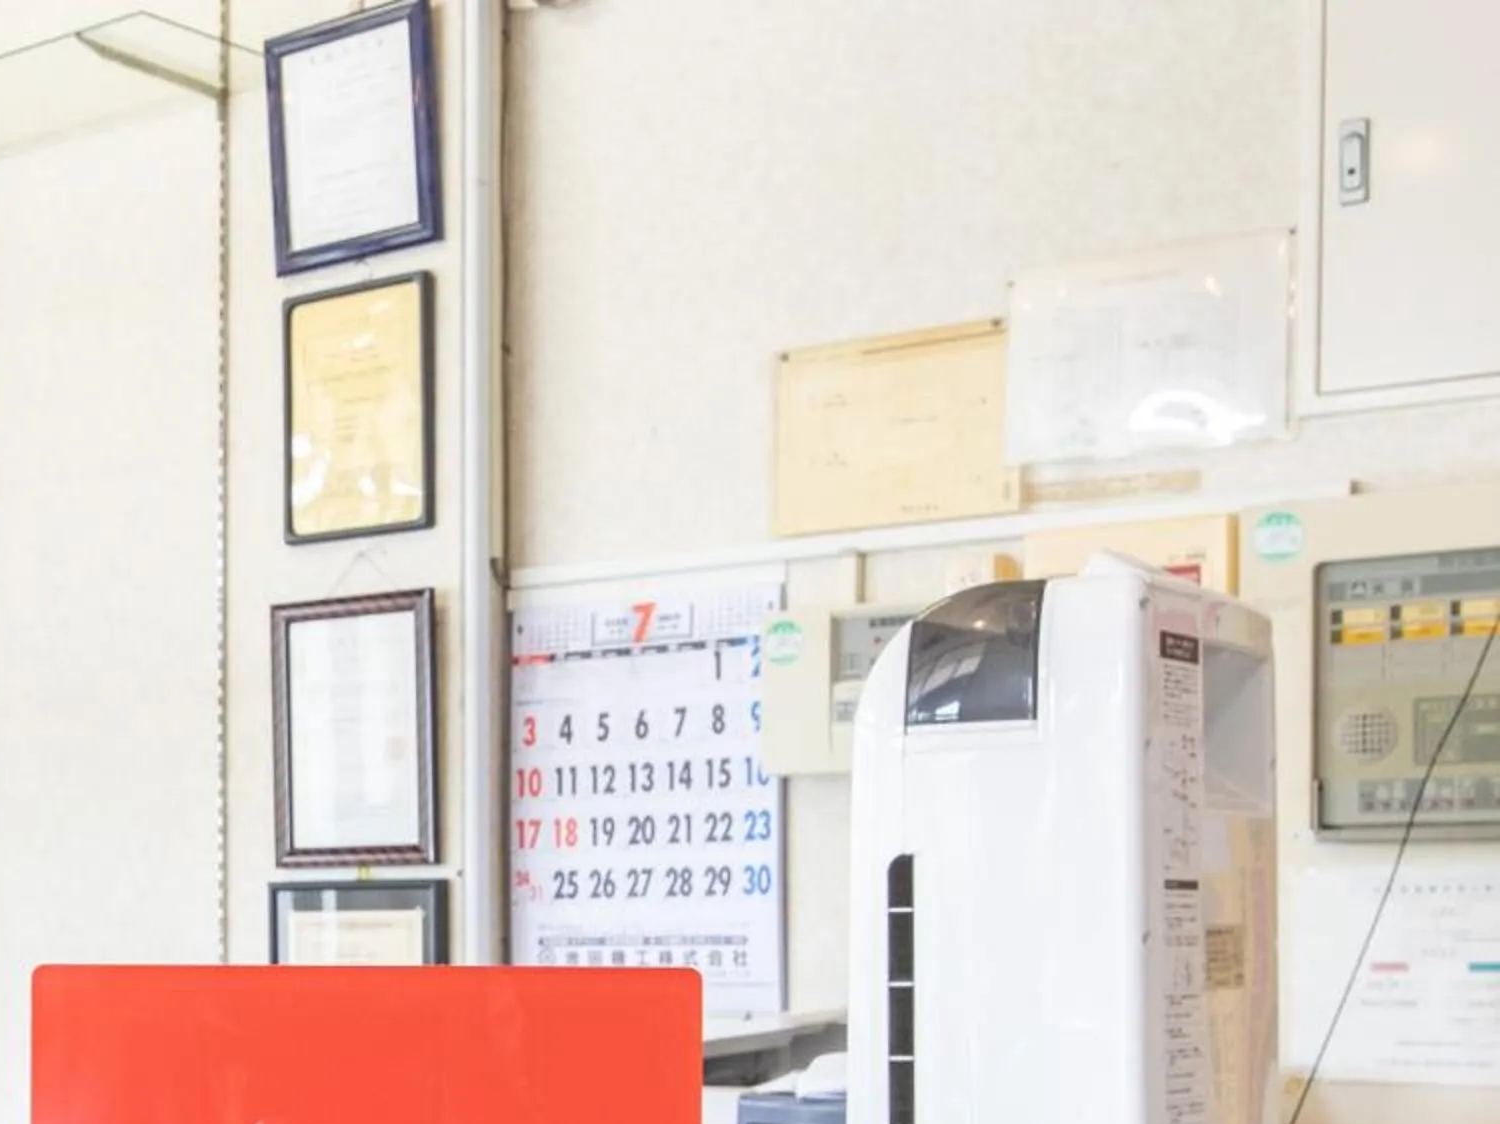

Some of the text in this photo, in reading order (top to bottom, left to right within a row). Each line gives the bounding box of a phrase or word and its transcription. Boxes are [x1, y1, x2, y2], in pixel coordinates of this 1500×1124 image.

[631, 602, 656, 643] 7
[713, 650, 722, 680] 1
[520, 716, 537, 748] 3
[559, 714, 573, 744] 4
[597, 712, 610, 742] 5
[634, 710, 649, 740] 6
[673, 706, 687, 737] 7
[711, 704, 726, 735] 8
[516, 768, 542, 798] 10
[555, 766, 577, 797] 11
[590, 764, 616, 794] 12
[628, 762, 655, 793] 13
[667, 760, 693, 791] 14
[706, 757, 732, 789] 15
[516, 809, 772, 850] 17 18 19 20 21 22 23
[553, 869, 579, 900] 25
[589, 868, 616, 899] 26
[627, 867, 653, 898] 27
[665, 866, 693, 897] 28
[704, 866, 732, 896] 29
[743, 864, 772, 896] 30
